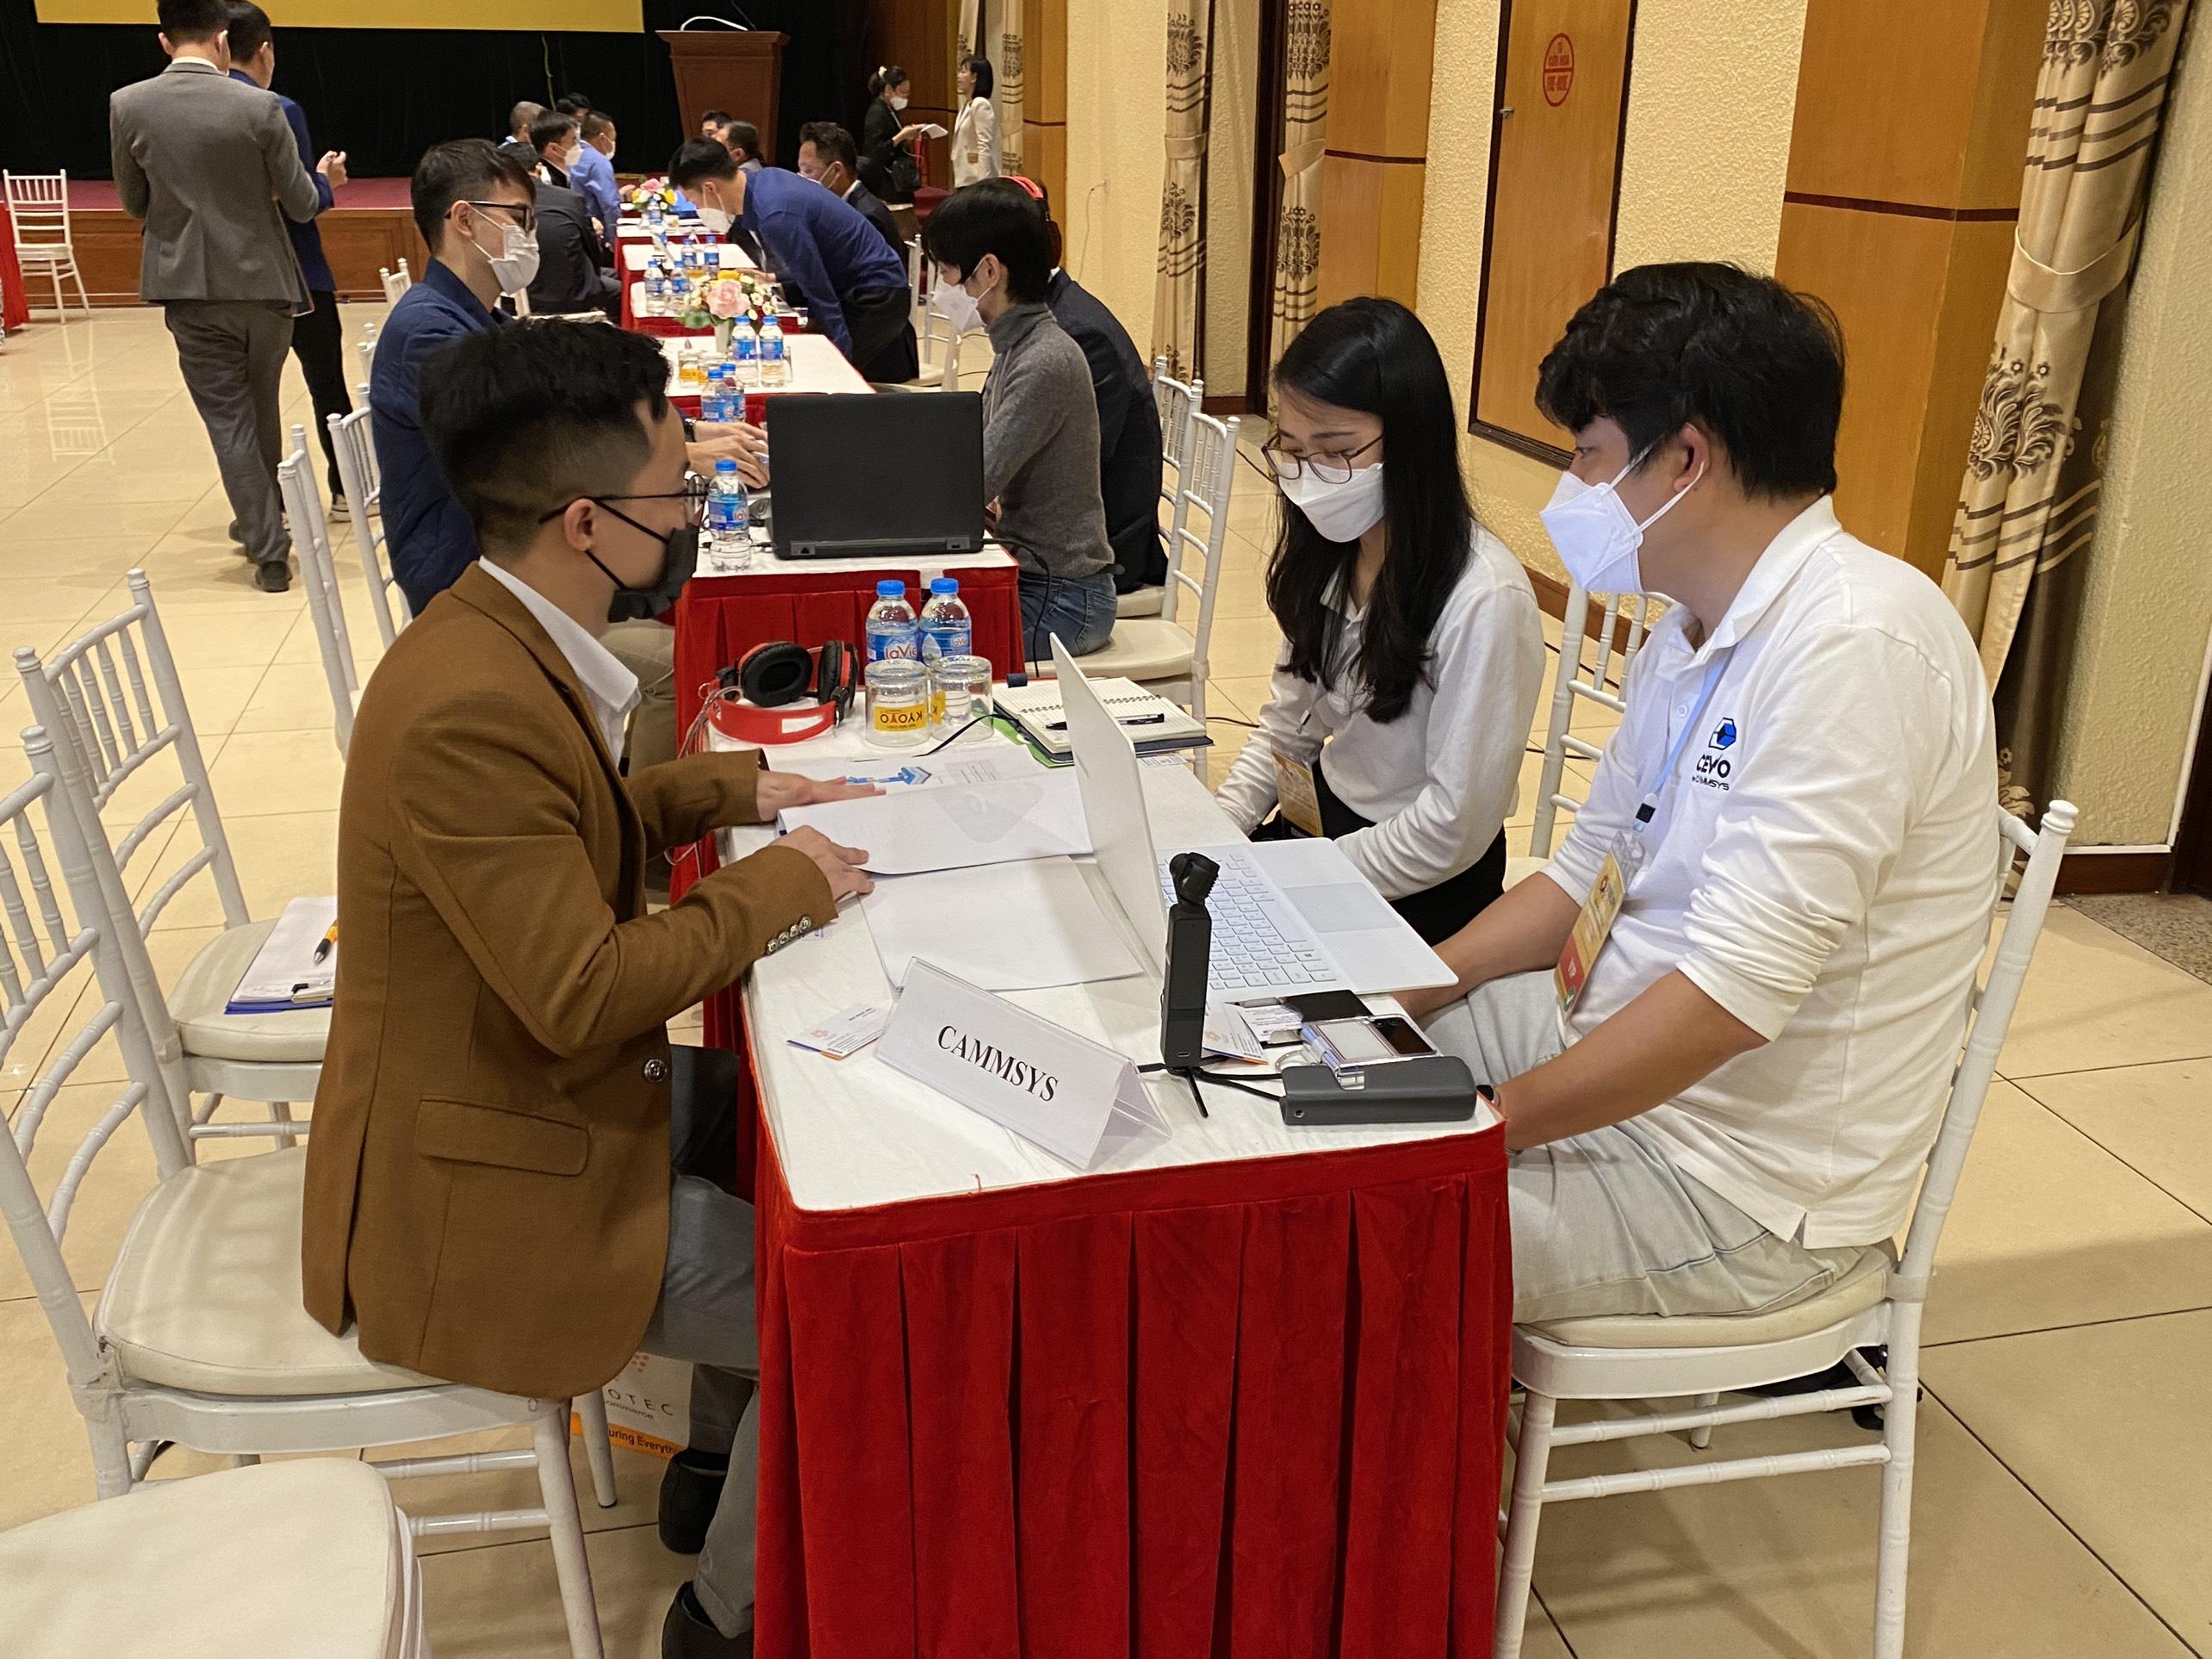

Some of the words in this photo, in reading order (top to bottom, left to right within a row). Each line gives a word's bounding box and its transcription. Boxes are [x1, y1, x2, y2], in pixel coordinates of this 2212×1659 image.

[880, 711, 923, 724] KYOTO
[937, 1025, 1059, 1102] CAMMSYS
[608, 1389, 673, 1416] OTEC
[609, 1429, 635, 1445] uring
